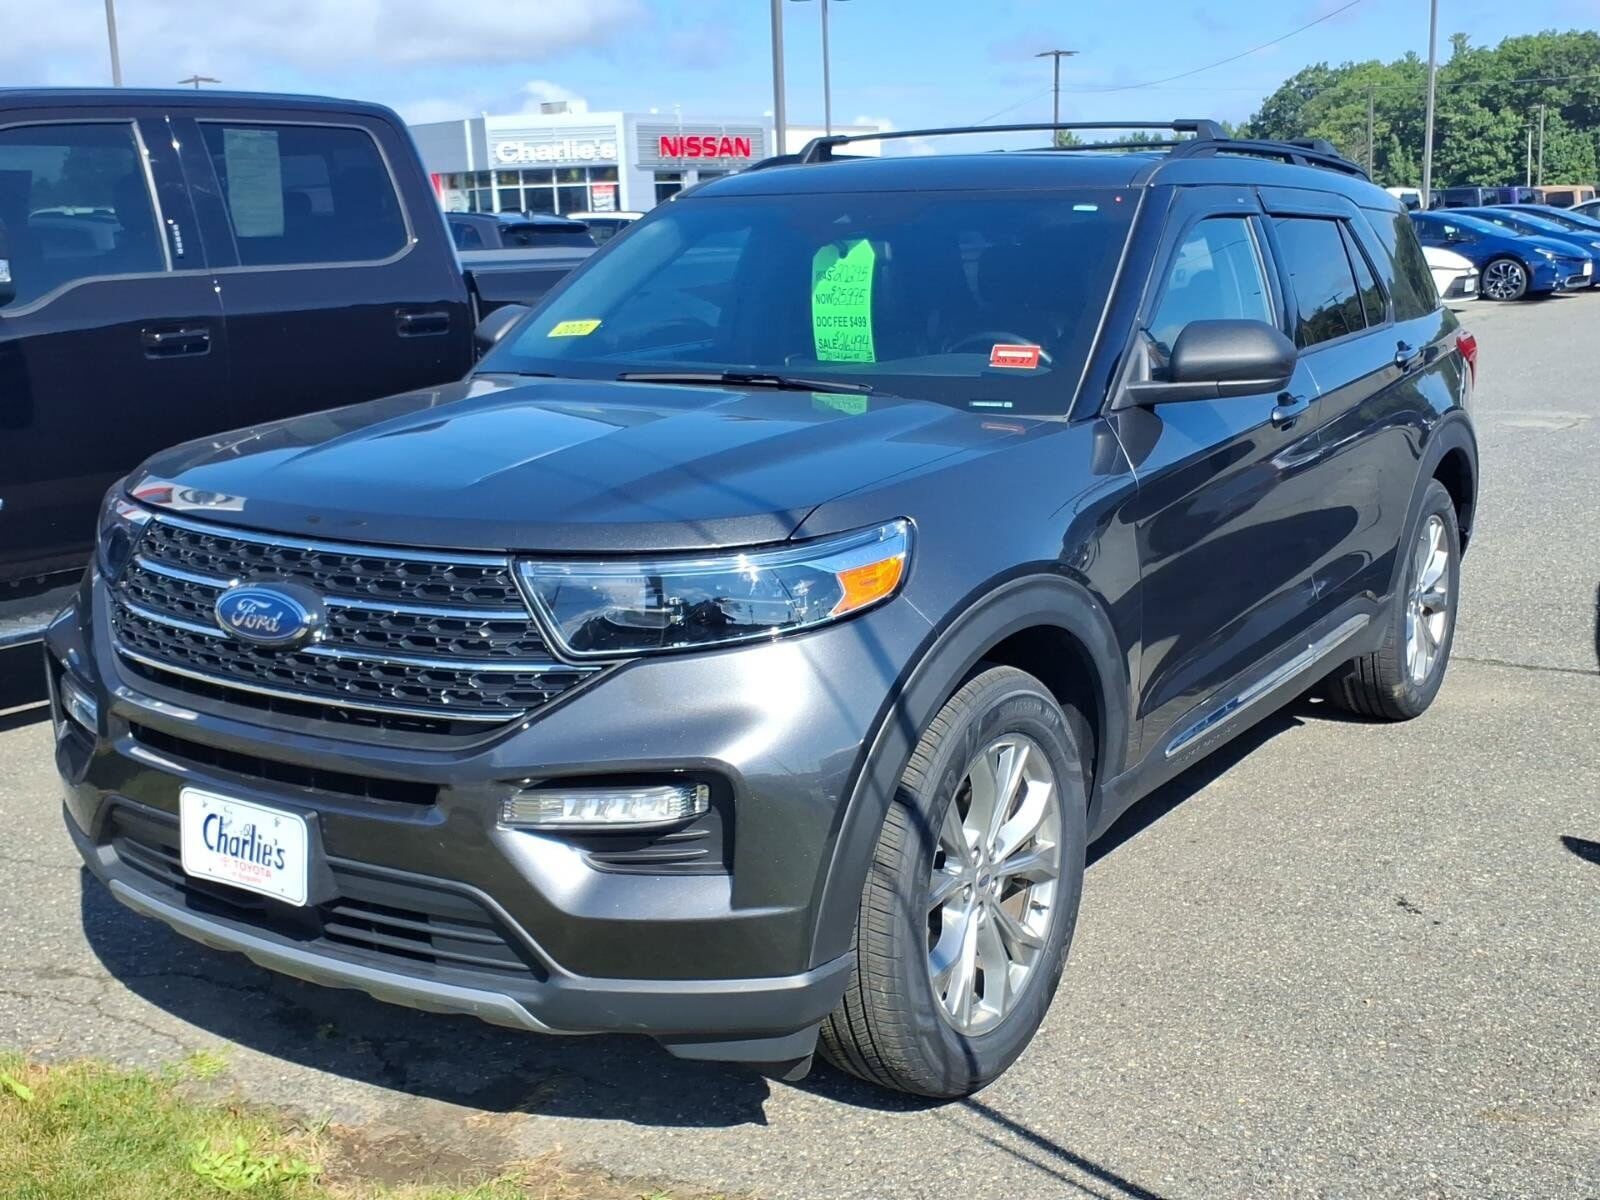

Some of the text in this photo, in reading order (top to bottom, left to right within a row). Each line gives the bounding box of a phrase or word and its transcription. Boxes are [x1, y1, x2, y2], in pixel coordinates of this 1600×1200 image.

[495, 140, 618, 163] Charlie's
[660, 135, 751, 158] NISSAN
[815, 293, 832, 305] NOW
[816, 315, 867, 328] DOC FEE $499
[818, 337, 837, 350] SALE
[231, 598, 284, 632] Ford
[203, 813, 285, 870] Charlie's
[233, 859, 273, 880] TOYOTA
